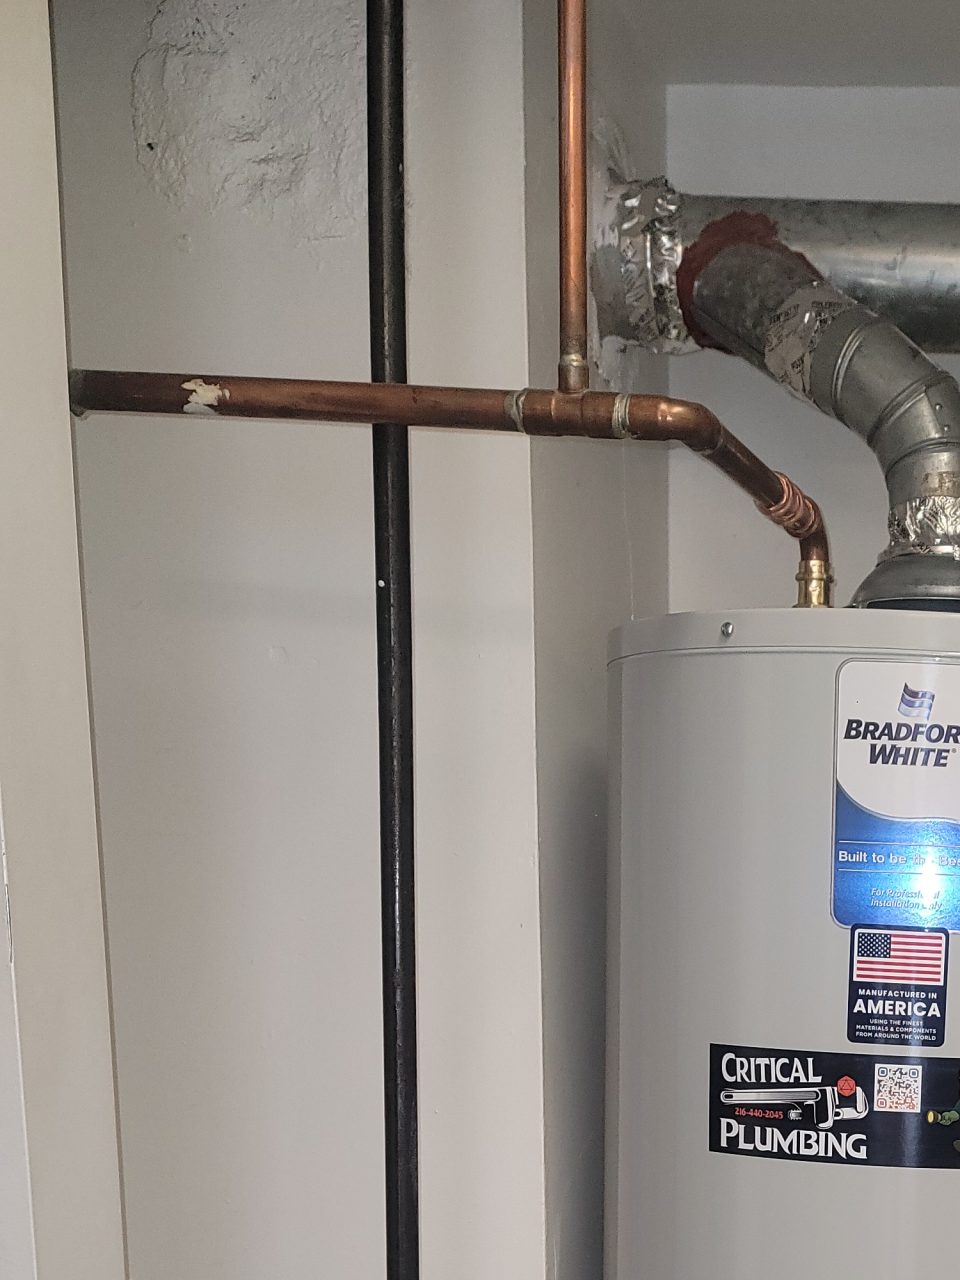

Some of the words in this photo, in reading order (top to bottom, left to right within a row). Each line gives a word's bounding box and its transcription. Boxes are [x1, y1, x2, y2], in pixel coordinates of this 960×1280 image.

[869, 743, 950, 767] WHITE
[838, 850, 868, 863] Built
[872, 852, 885, 863] to
[889, 853, 907, 865] be
[871, 888, 884, 897] For
[870, 895, 919, 908] Installation
[858, 988, 926, 998] MANUFACTURED
[853, 999, 941, 1018] AMERICA
[721, 1052, 822, 1083] CRITICAL
[735, 1107, 784, 1119] 216-440-2045
[720, 1117, 868, 1159] PLUMBING
